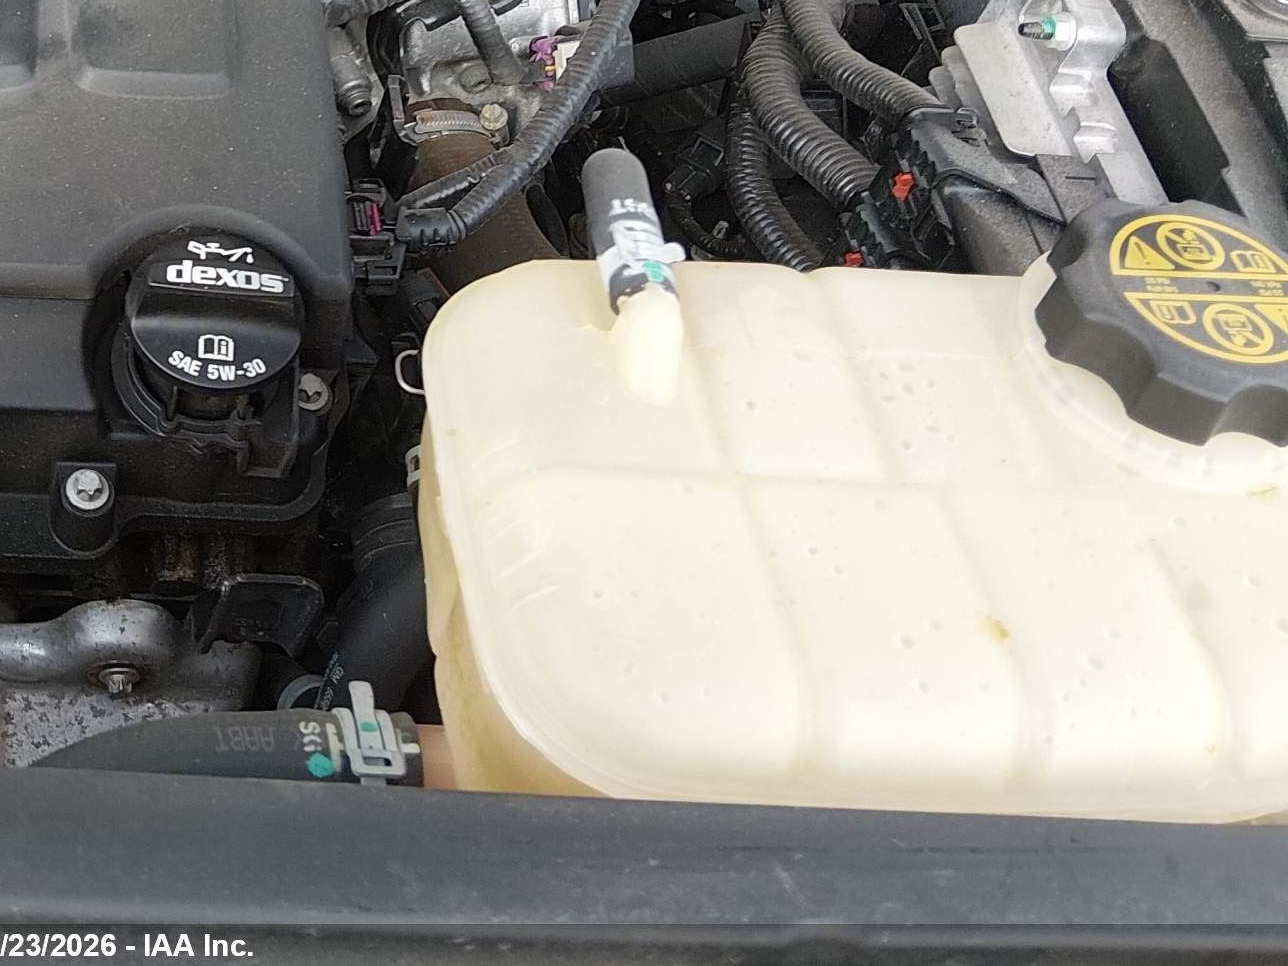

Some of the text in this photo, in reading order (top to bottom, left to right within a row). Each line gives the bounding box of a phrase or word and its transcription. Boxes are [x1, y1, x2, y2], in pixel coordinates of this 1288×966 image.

[166, 260, 285, 293] dexos
[168, 351, 266, 381] SAE 5W-30
